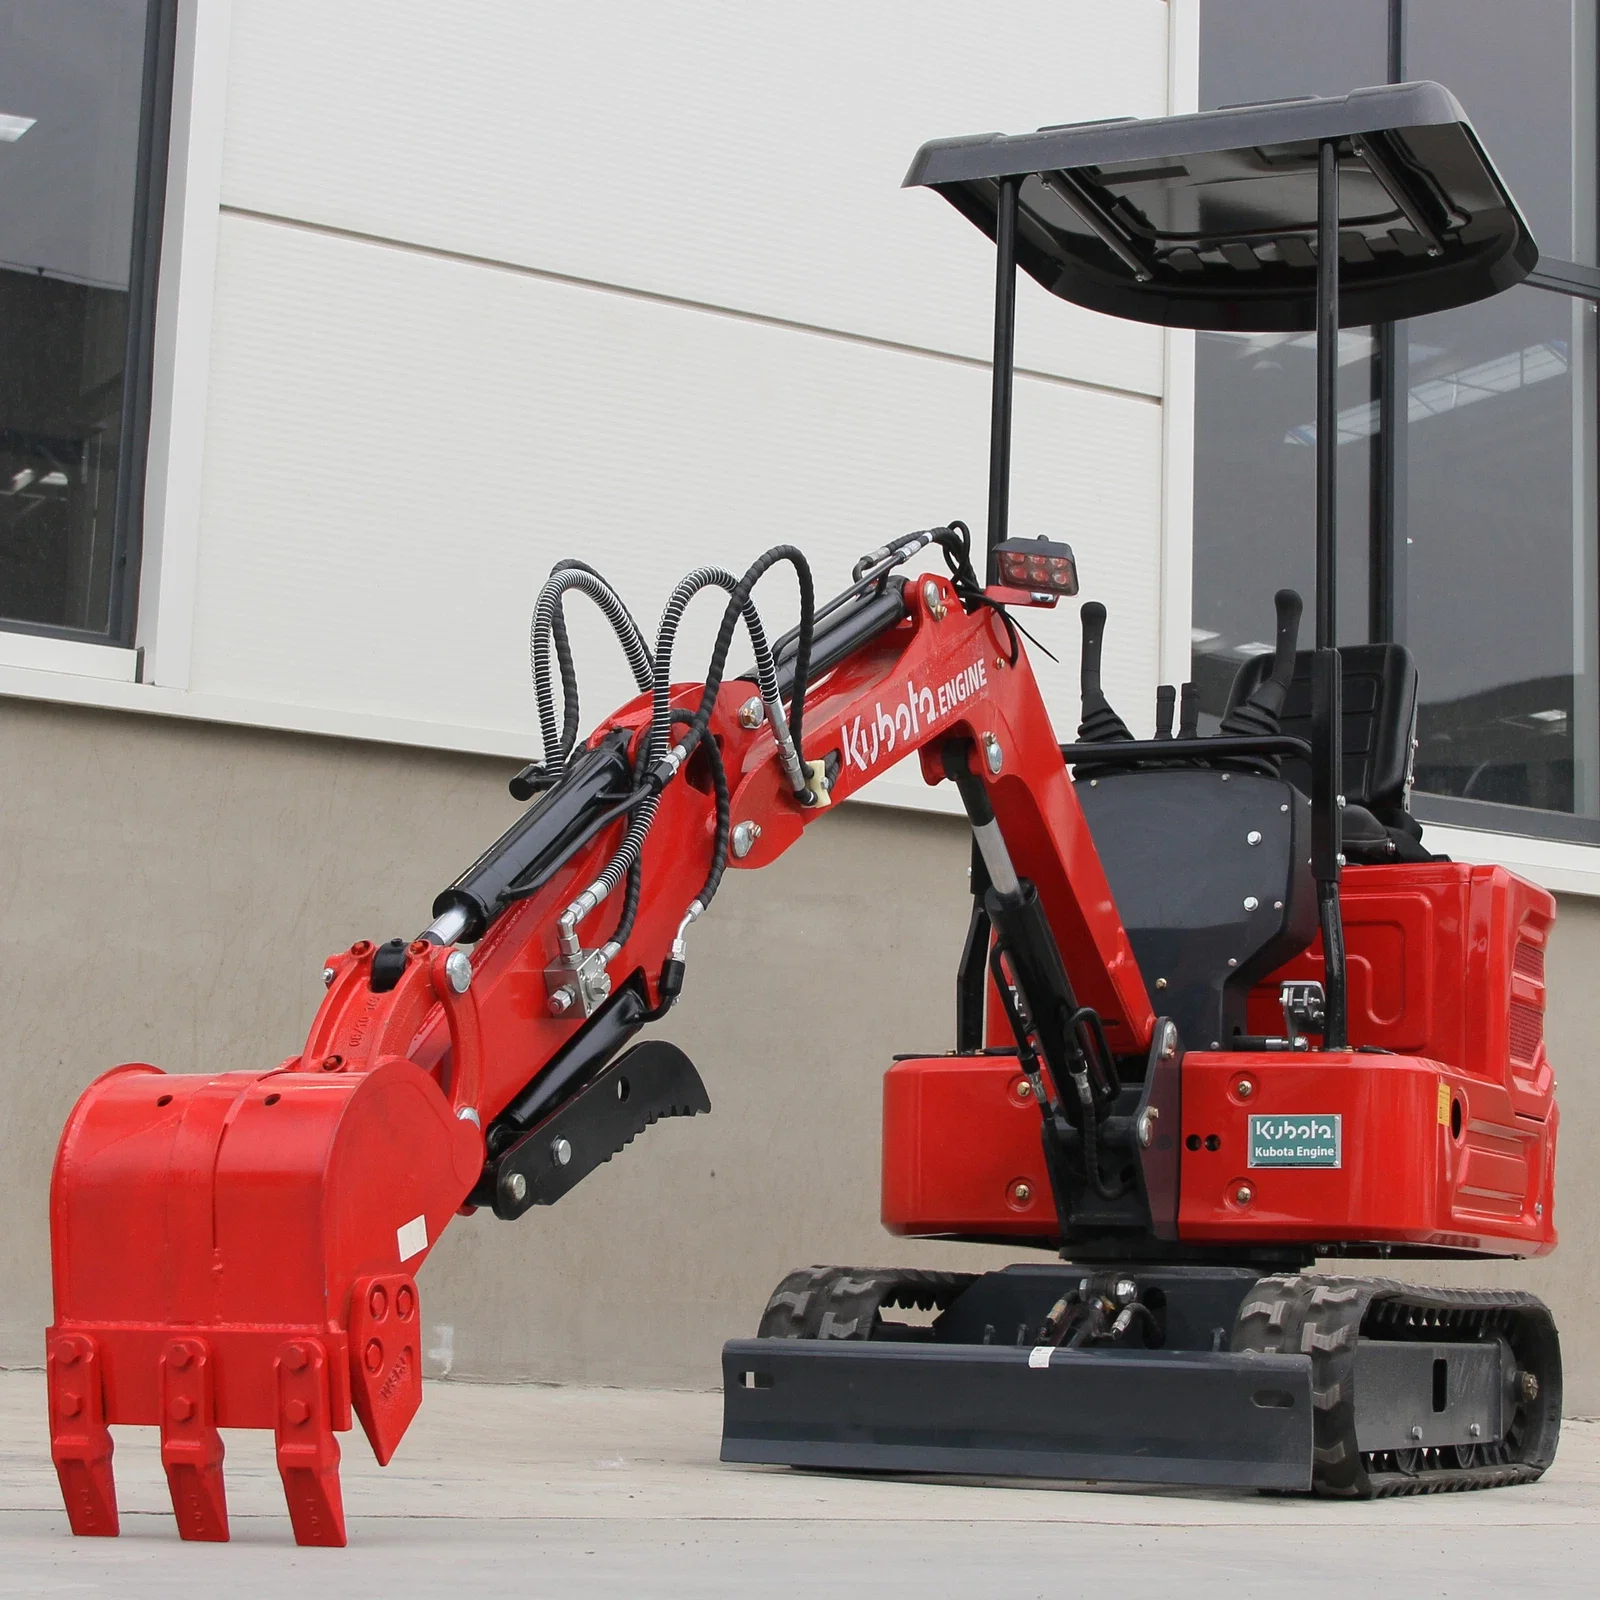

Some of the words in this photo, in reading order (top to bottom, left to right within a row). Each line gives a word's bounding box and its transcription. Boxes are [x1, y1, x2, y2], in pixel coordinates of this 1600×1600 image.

[841, 680, 937, 772] Kubota
[937, 657, 988, 716] ENGINE
[1255, 1120, 1332, 1140] Kubota
[1255, 1146, 1294, 1157] Kubota
[1296, 1146, 1335, 1159] Engine
